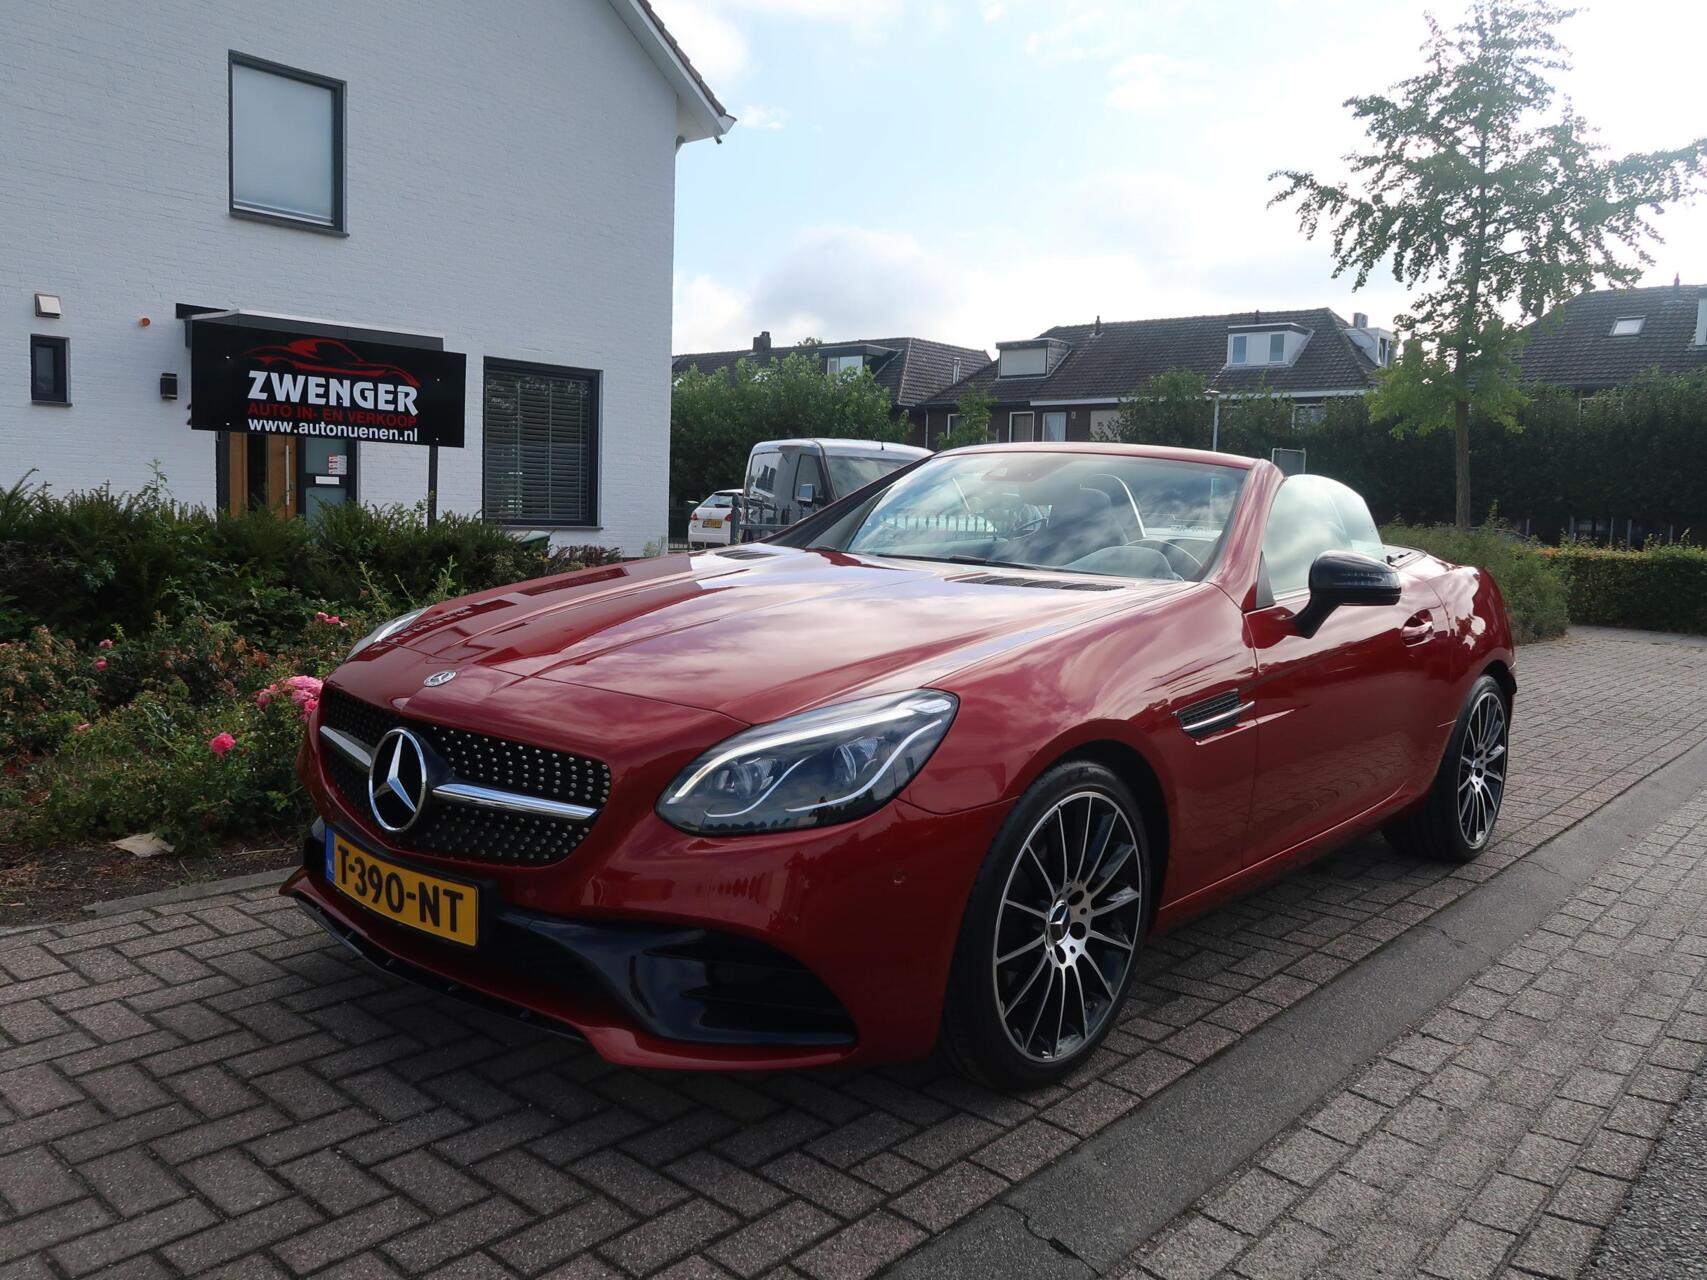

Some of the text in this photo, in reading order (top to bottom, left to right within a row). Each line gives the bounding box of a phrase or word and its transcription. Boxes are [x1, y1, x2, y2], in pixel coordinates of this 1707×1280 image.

[248, 370, 419, 416] ZWENGER
[248, 402, 292, 417] AUTO
[323, 408, 343, 422] EN
[348, 410, 417, 428] VERKOOP
[248, 418, 418, 442] www.autonuenen.nl
[337, 844, 464, 933] T-390-NT
